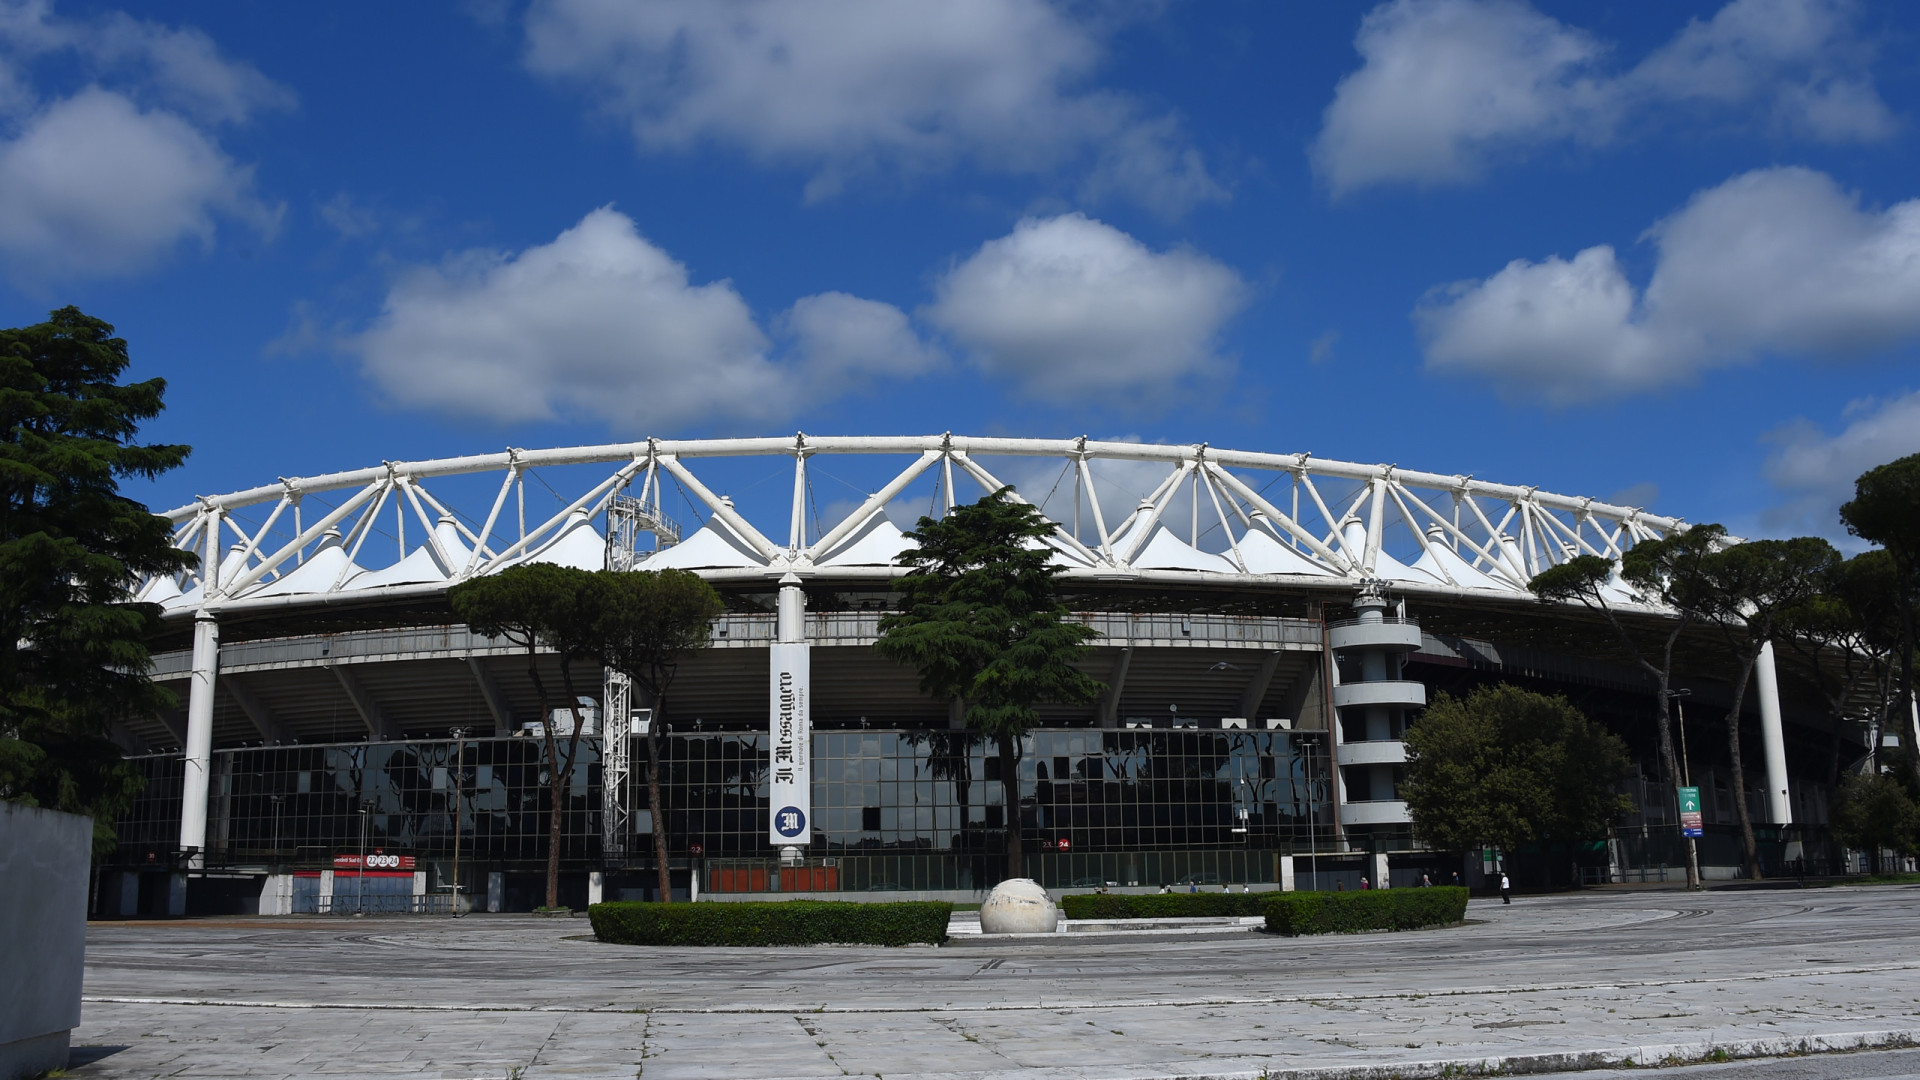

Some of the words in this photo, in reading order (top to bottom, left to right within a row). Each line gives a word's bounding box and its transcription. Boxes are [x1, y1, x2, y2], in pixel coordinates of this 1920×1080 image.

[797, 685, 805, 708] sempre.
[775, 671, 796, 764] Messaggero
[797, 709, 804, 717] da
[797, 743, 805, 766] giornale
[775, 767, 794, 785] Il
[368, 856, 378, 864] 22
[379, 856, 388, 864] 23
[389, 856, 398, 864] 24
